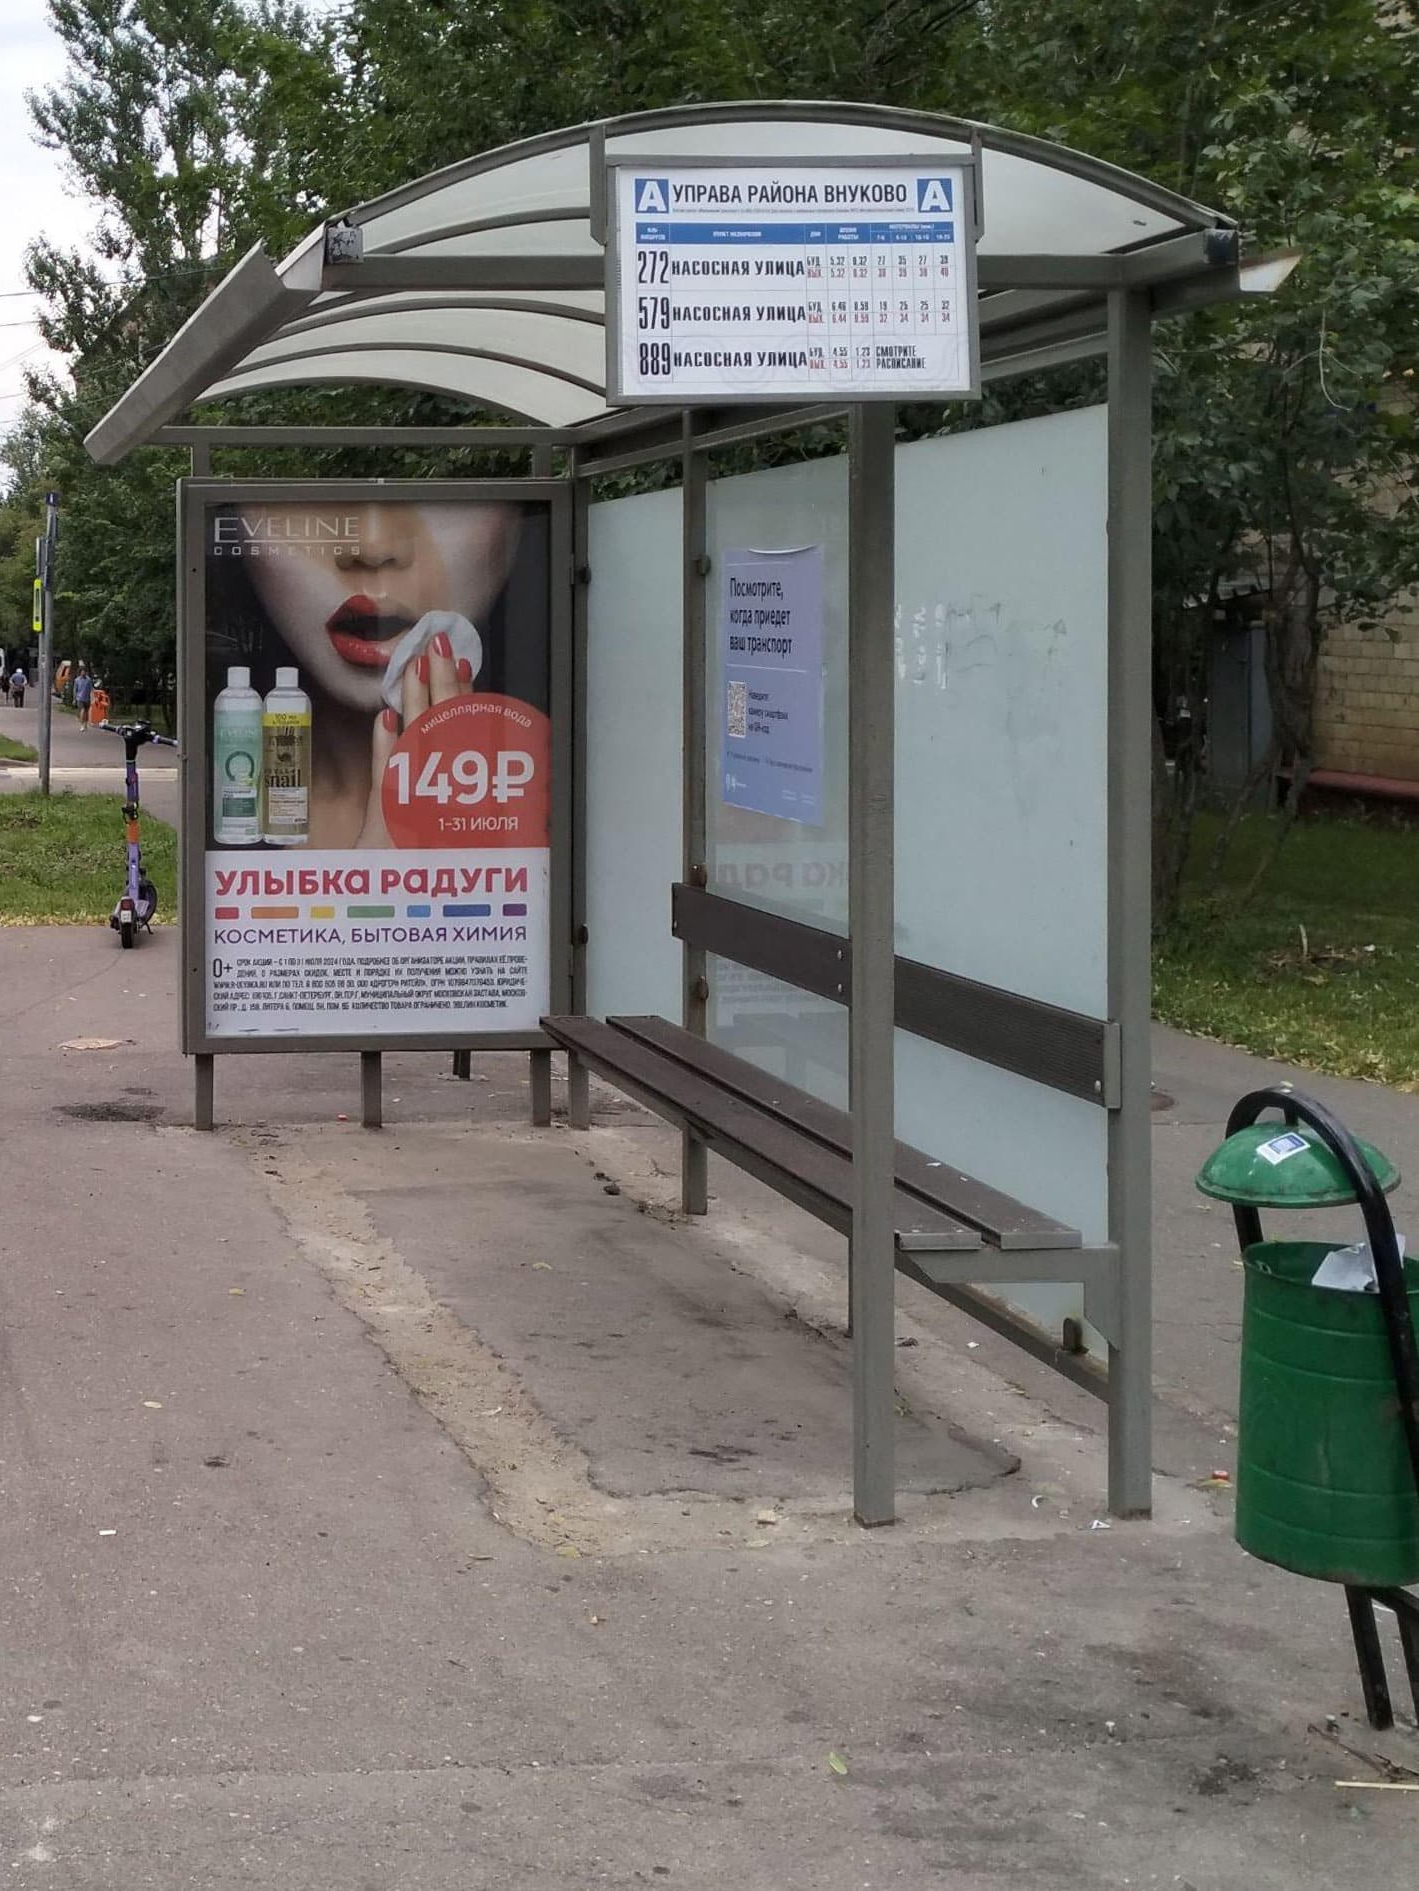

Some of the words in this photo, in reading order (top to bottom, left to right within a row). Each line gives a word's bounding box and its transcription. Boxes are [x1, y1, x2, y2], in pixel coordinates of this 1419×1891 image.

[673, 184, 742, 204] УПРАВА
[747, 180, 816, 204] РАЙОНА
[824, 183, 907, 203] ВНУКОВО
[638, 250, 669, 284] 272
[672, 260, 750, 276] НАСОСНАЯ
[754, 260, 805, 278] УЛИЦА
[639, 297, 670, 330] 579
[673, 306, 751, 321] НАСОСНАЯ
[756, 306, 806, 323] УЛИЦА
[639, 343, 671, 376] 889
[674, 352, 753, 367] НАСОСНАЯ
[757, 352, 808, 368] УЛИЦА
[214, 516, 360, 544] EVELINE
[214, 546, 361, 556] COSMETICS
[730, 577, 784, 602] Посмотрите,
[730, 608, 753, 627] когда
[754, 609, 791, 629] приедет
[730, 636, 746, 652] ваш
[747, 638, 793, 658] транспорт
[421, 703, 502, 734] мицеллярная
[503, 707, 532, 728] вода
[470, 816, 519, 831] ИЮЛЯ
[214, 927, 346, 945] КОСМЕТИКА,
[351, 926, 448, 943] БЫТОВАЯ
[452, 925, 527, 942] ХИМИЯ
[212, 957, 233, 978] 0+
